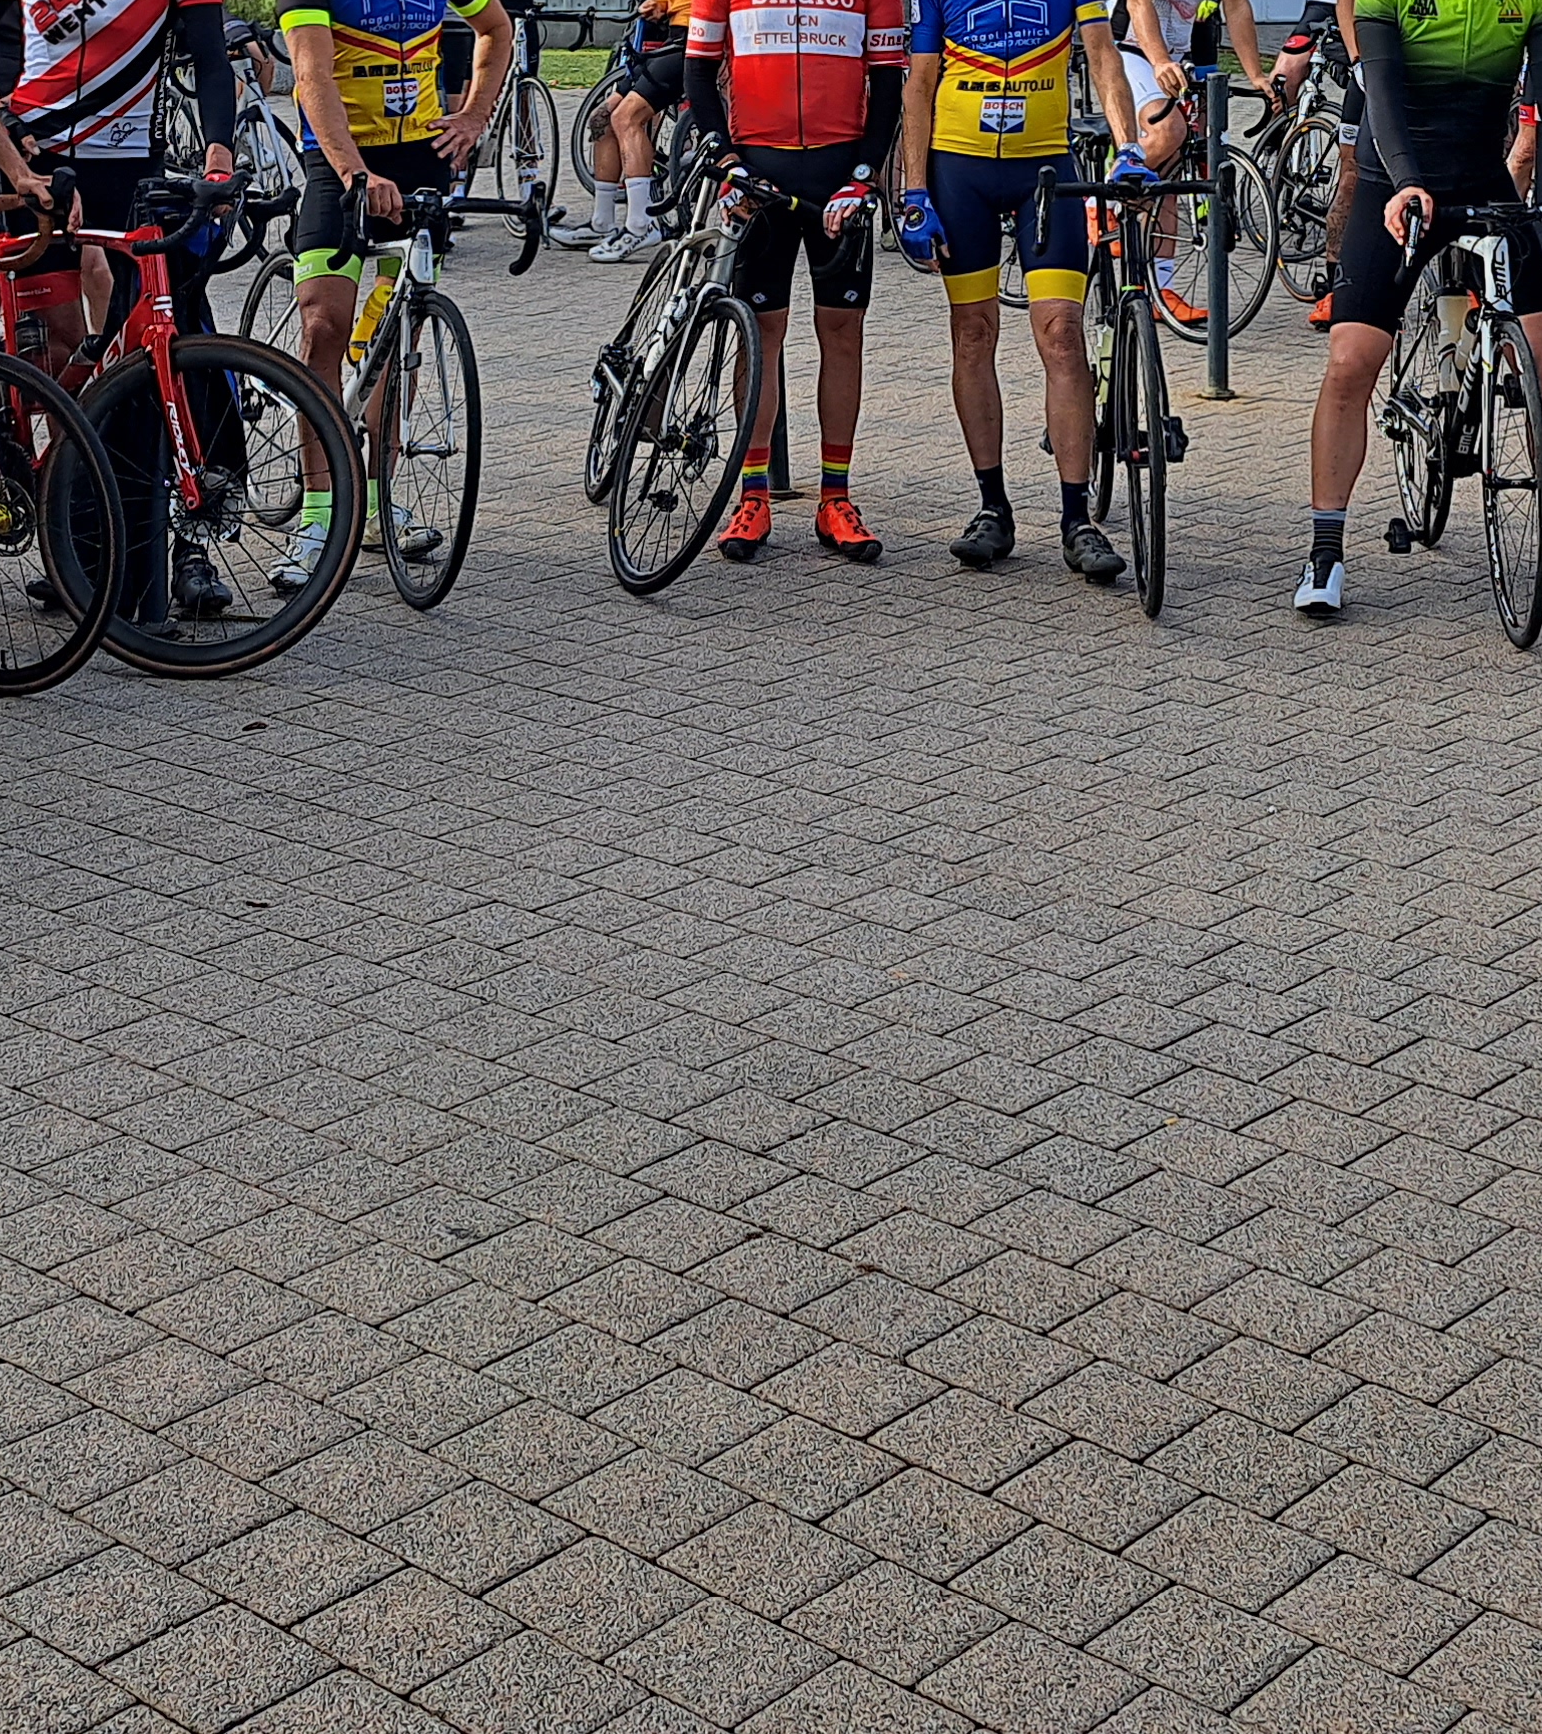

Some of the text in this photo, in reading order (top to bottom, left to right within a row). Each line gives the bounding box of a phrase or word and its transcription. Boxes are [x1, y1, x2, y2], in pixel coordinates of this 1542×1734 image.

[787, 14, 819, 27] UCN
[754, 32, 847, 47] ETTELBRUCK
[1004, 78, 1055, 93] AUTO.LU
[984, 101, 1024, 111] BOSCH
[1495, 250, 1507, 298] BMC
[1457, 424, 1475, 455] BMC
